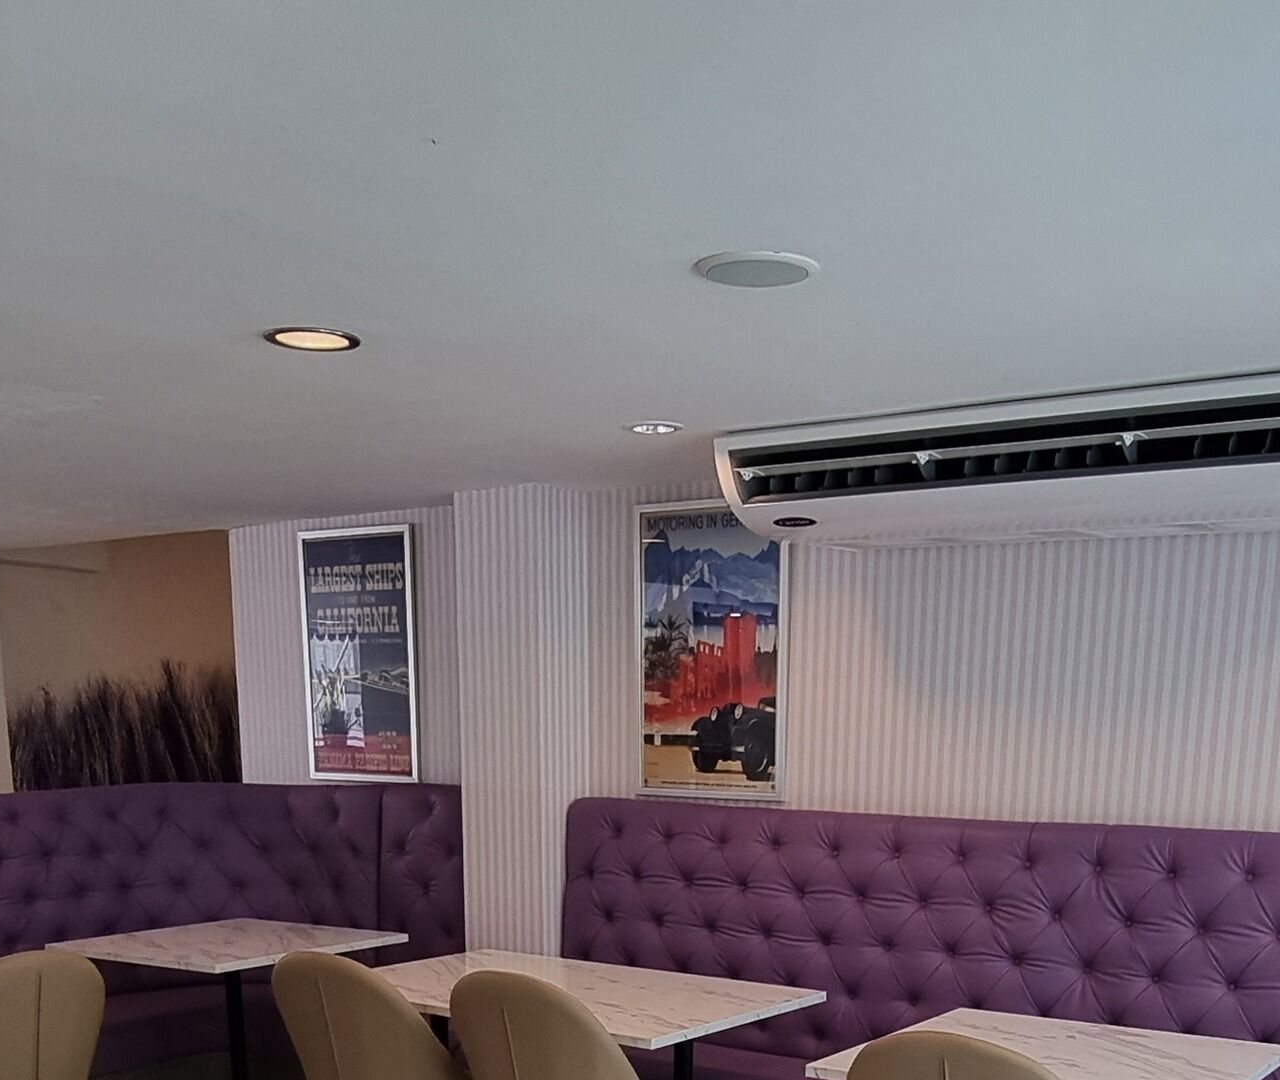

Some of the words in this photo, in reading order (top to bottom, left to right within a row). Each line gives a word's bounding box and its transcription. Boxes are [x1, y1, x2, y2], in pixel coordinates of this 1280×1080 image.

[646, 513, 704, 533] MOTORING
[706, 512, 718, 529] IN
[309, 565, 362, 594] LARGEST
[365, 562, 404, 592] SHIPS
[316, 605, 400, 635] CALIFORNIA
